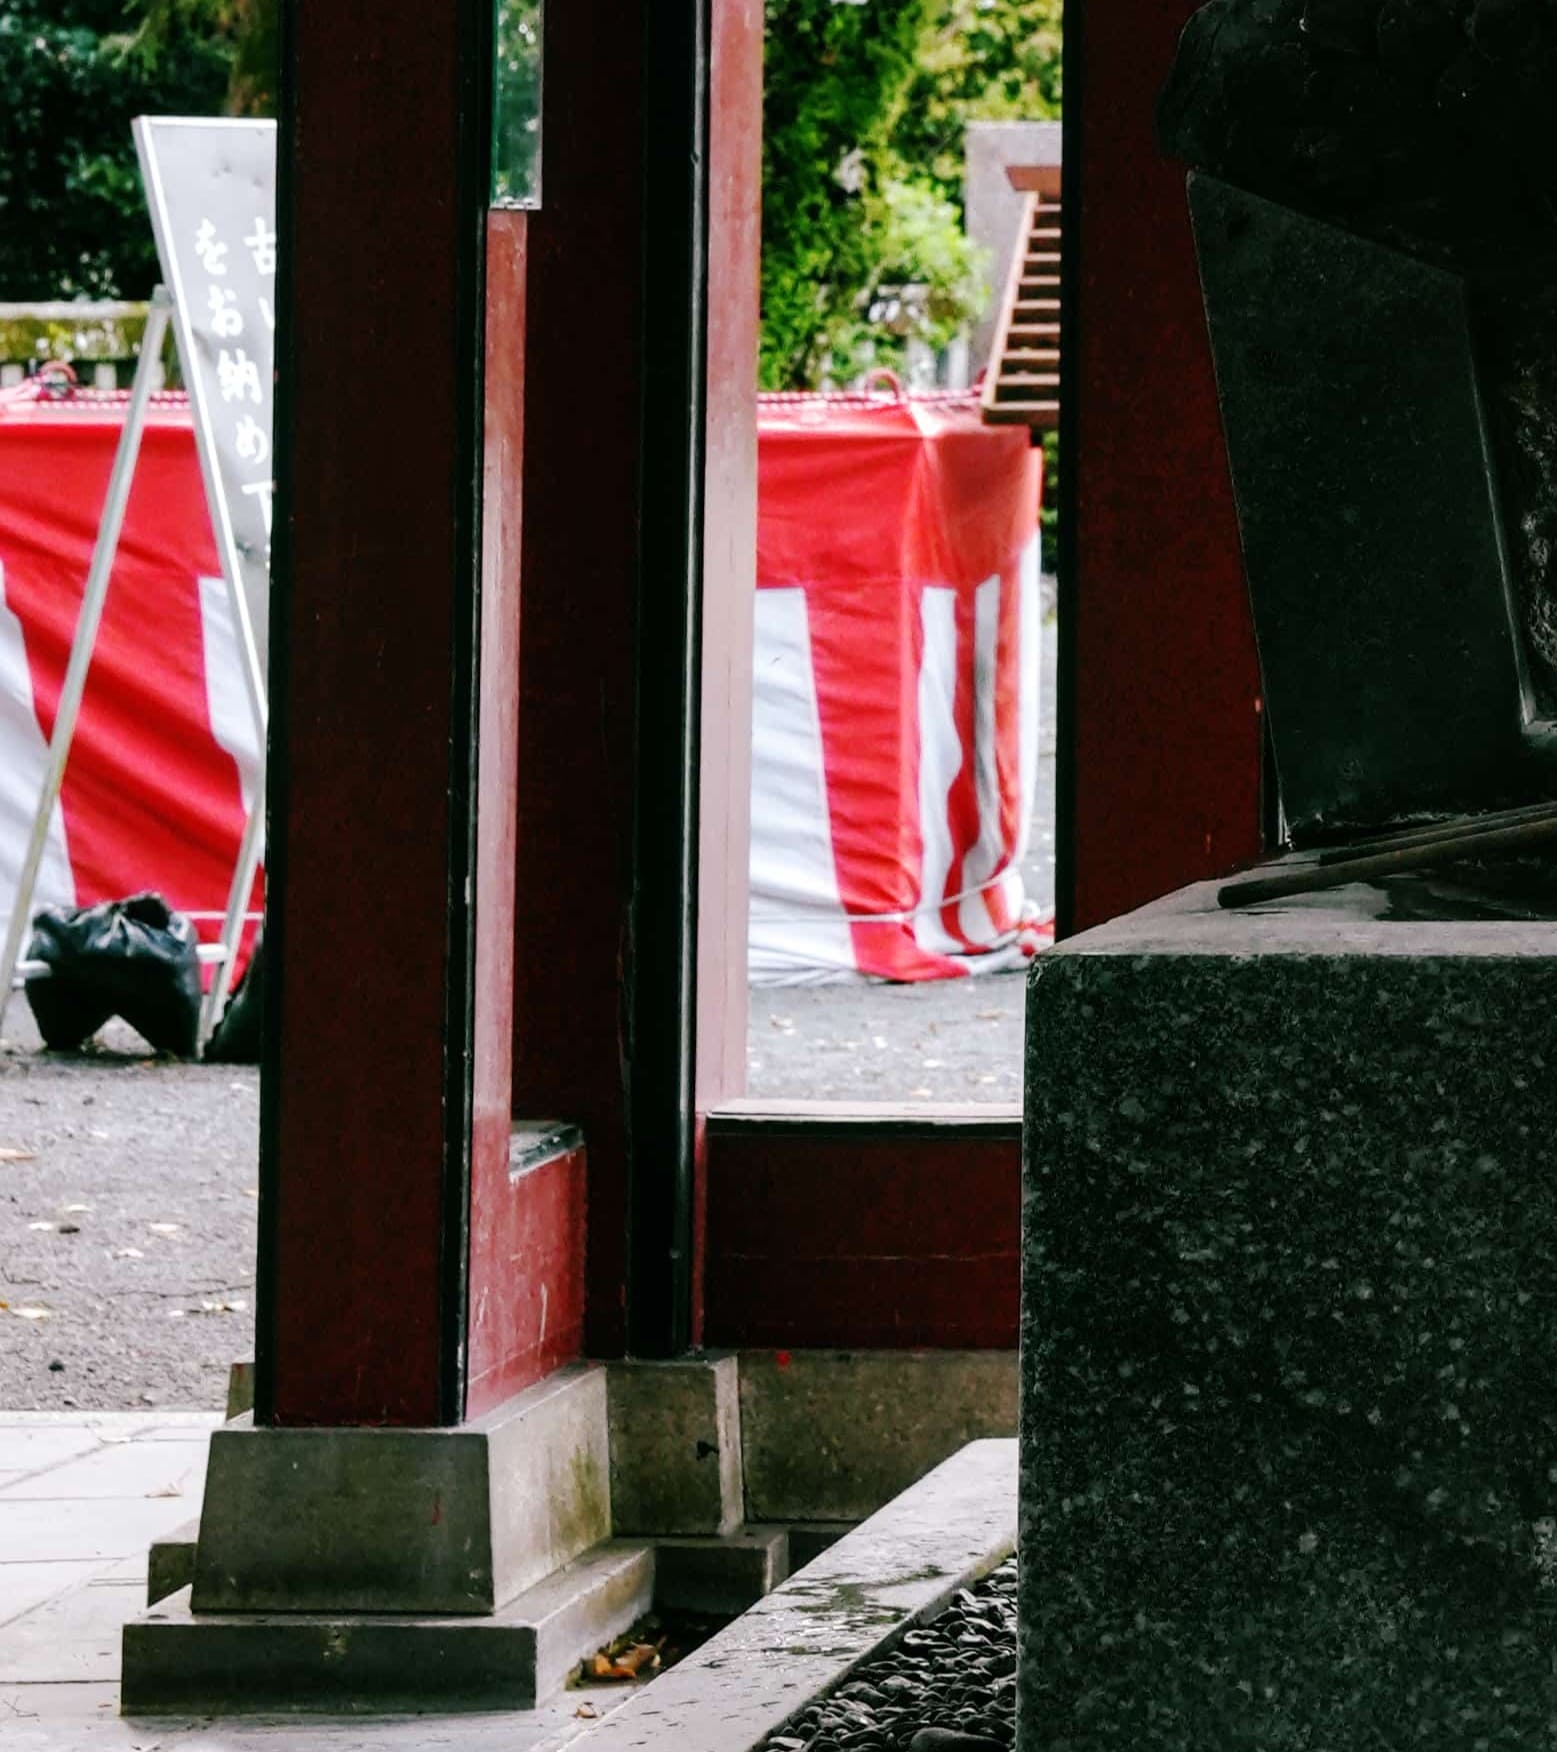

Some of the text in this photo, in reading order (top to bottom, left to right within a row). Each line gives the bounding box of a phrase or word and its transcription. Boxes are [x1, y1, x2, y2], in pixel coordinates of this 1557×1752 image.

[194, 218, 276, 572] をお納め下
